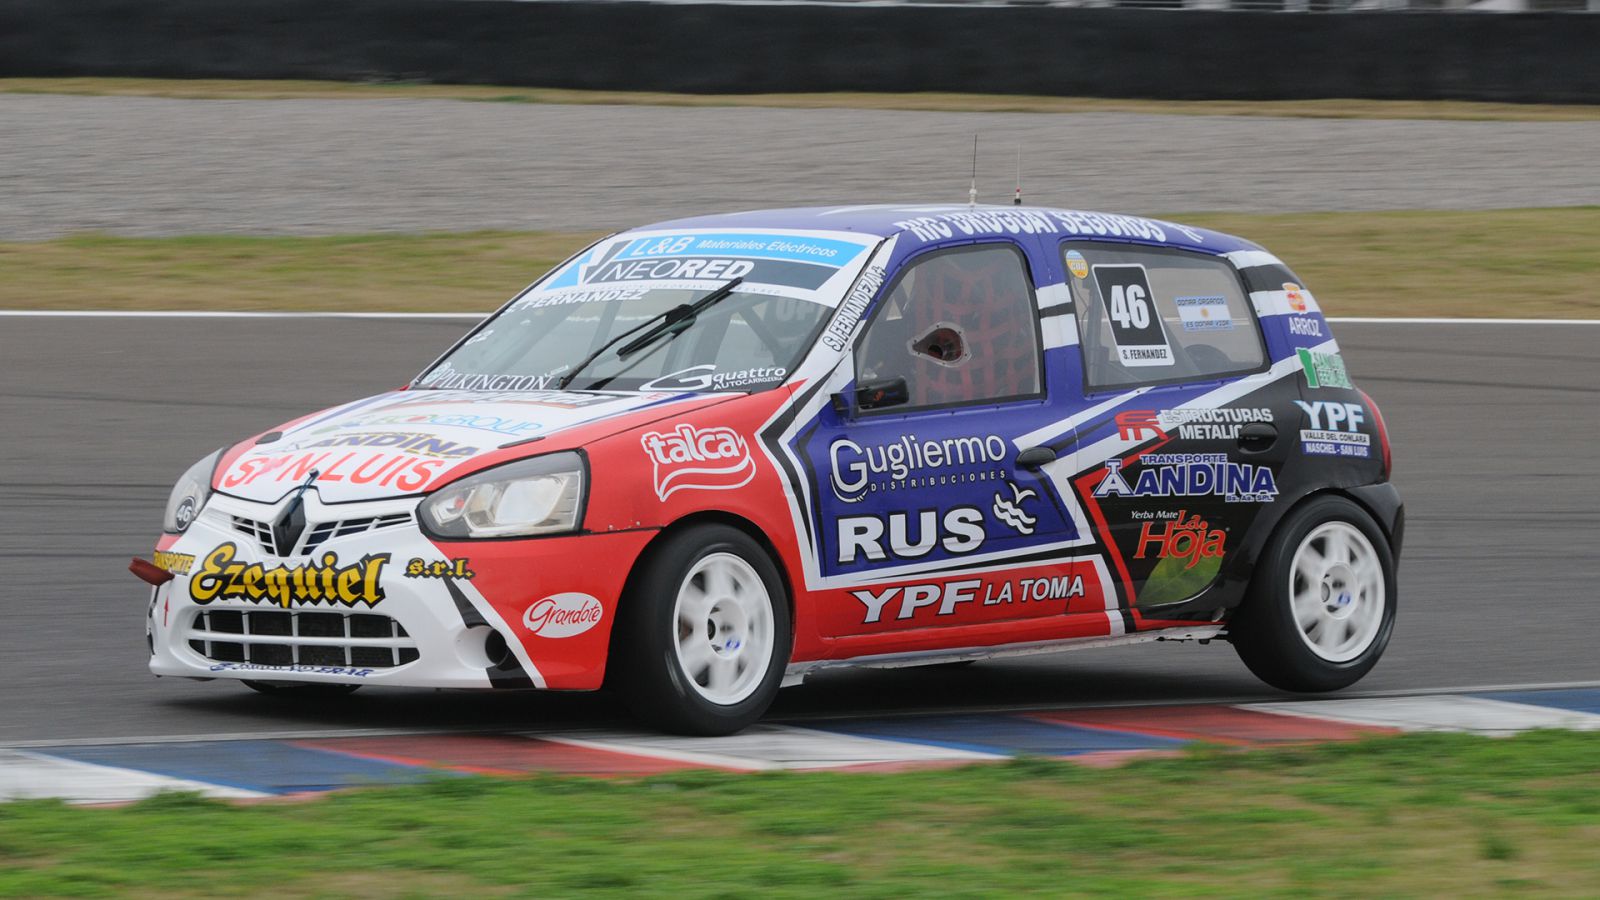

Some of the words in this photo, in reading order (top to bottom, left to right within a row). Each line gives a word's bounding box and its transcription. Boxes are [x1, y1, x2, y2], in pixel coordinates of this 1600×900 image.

[1050, 209, 1166, 242] SEGUROS
[631, 236, 696, 257] L&B
[696, 238, 765, 250] Materiales
[767, 239, 838, 258] Eléctricos
[600, 259, 755, 282] NEORED
[1110, 284, 1150, 329] 46
[1288, 316, 1323, 337] ARROZ
[1122, 349, 1130, 360] S.
[1130, 349, 1168, 359] FERNANDEZ
[432, 368, 553, 391] PILKINGTON
[712, 367, 787, 384] quattro
[1159, 407, 1274, 423] ESTRUCTURAS
[1293, 400, 1364, 432] YPF
[1178, 424, 1243, 440] METALIC
[1304, 432, 1325, 440] VALLE
[1326, 433, 1338, 441] DEL
[305, 432, 481, 457] ANDINA
[648, 424, 741, 464] talca
[830, 434, 1007, 493] Gugliermo
[1140, 453, 1227, 465] TRANSPORTE
[316, 452, 445, 492] LUIS
[871, 469, 1006, 492] DISTRIBUCIONES
[1133, 461, 1279, 496] ANDINA
[177, 505, 192, 522] 46
[1131, 510, 1155, 519] Yerba
[1156, 510, 1178, 519] Mate
[1174, 509, 1202, 530] La
[837, 506, 987, 563] RUS
[1133, 521, 1226, 570] Hoja
[190, 542, 391, 609] Ezequiel
[402, 557, 477, 580] s.r.l.
[850, 579, 982, 624] YPF
[983, 583, 1013, 606] LA
[1020, 575, 1085, 602] TOMA
[528, 597, 601, 633] Grandote
